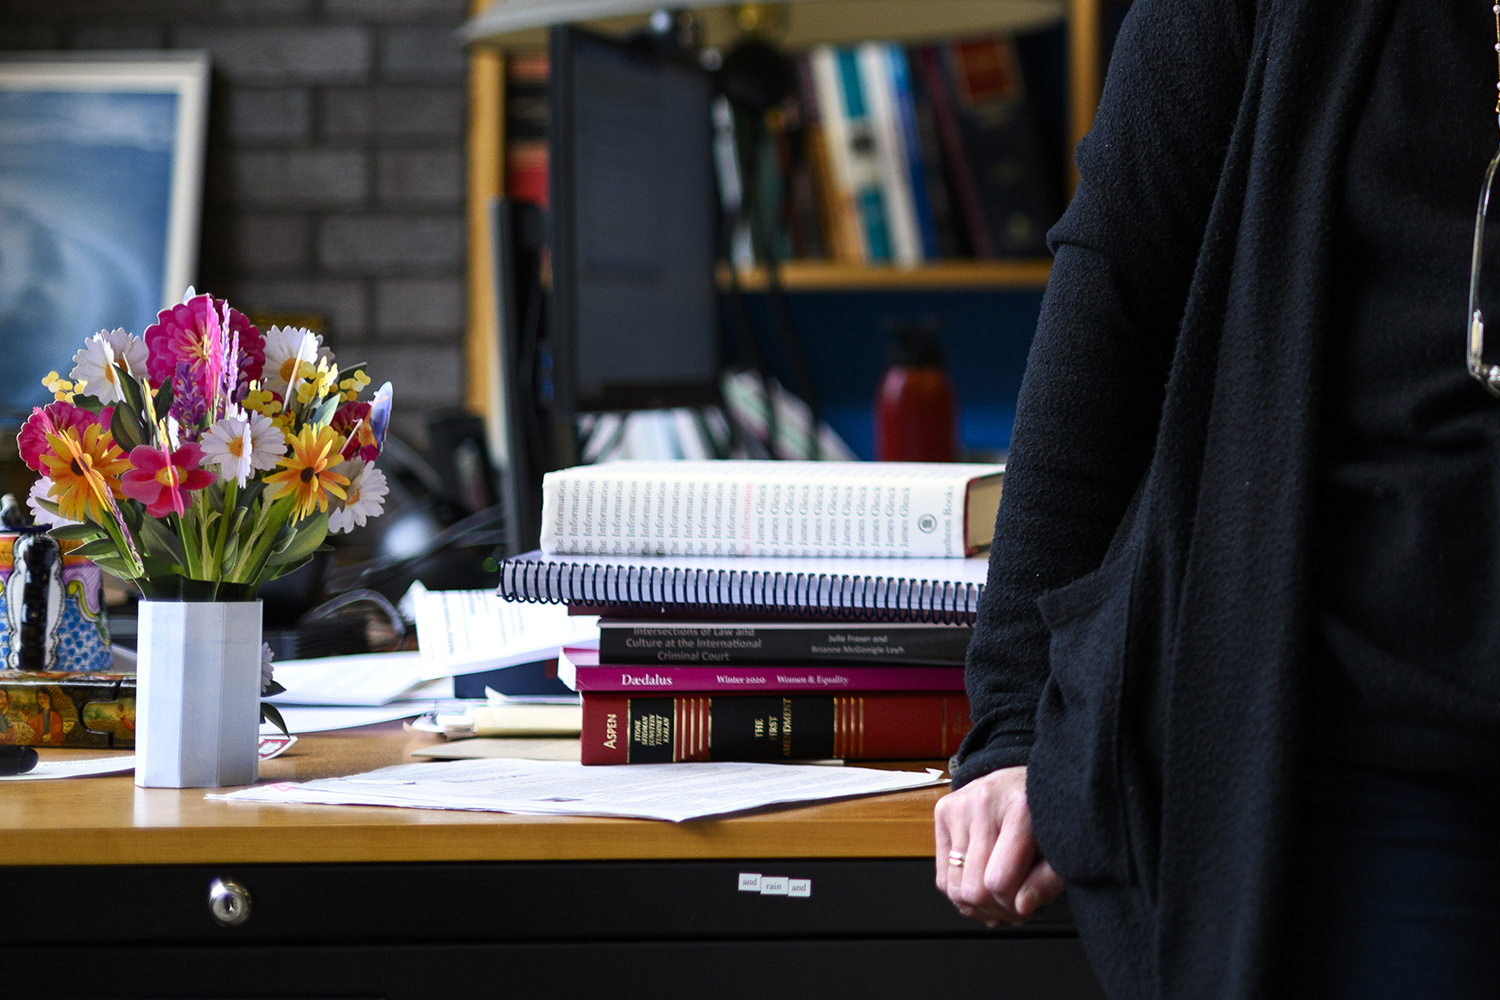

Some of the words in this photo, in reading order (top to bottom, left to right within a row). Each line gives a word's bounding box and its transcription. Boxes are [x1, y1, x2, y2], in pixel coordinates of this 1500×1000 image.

[756, 484, 766, 515] Gleick
[770, 484, 781, 515] Gleick
[785, 485, 795, 515] Gleick
[799, 485, 810, 516] Gleick
[814, 485, 824, 516] Gleick
[828, 486, 838, 516] Gleick
[842, 486, 853, 516] Gleick
[857, 486, 867, 516] Gleick
[871, 486, 882, 517] Gleick
[886, 487, 896, 517] Gleick
[900, 487, 910, 517] Gleick
[626, 638, 663, 648] Culture
[665, 638, 676, 648] at
[678, 638, 695, 648] the
[697, 638, 762, 648] International
[713, 628, 734, 636] Law
[736, 628, 755, 636] and
[658, 650, 700, 661] Criminal
[702, 651, 730, 661] Court
[622, 674, 673, 686] Dædalus
[716, 675, 744, 684] Winter
[776, 675, 807, 684] Women
[808, 675, 816, 684] &
[816, 675, 848, 686] Equality
[604, 713, 618, 750] ASPEN
[634, 720, 642, 742] STONE
[754, 718, 764, 738] THE
[782, 697, 792, 757] AMENDMENT
[766, 882, 782, 890] rain
[792, 884, 806, 892] and
